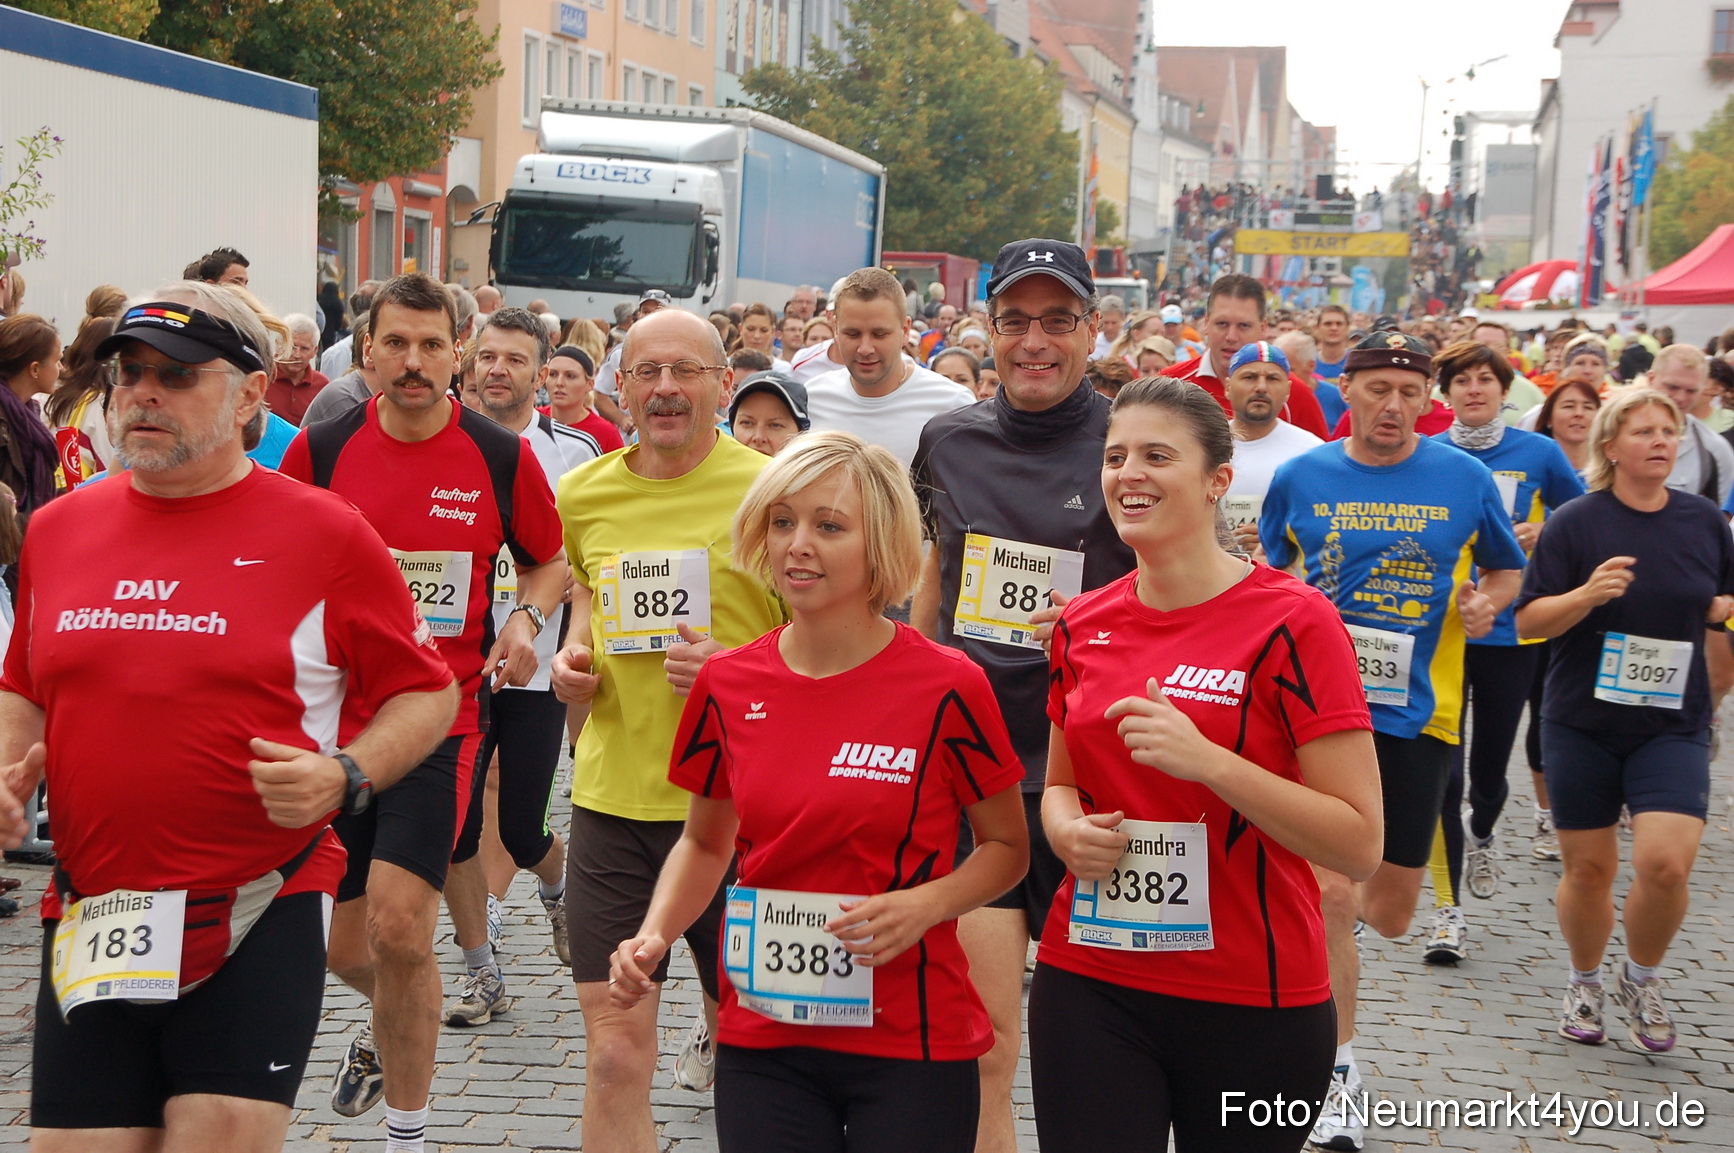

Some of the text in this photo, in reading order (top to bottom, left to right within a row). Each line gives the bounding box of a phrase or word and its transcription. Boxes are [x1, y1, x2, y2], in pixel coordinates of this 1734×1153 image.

[557, 162, 652, 184] BOCK
[1291, 235, 1349, 250] START
[431, 486, 481, 503] Lauftreff
[429, 505, 477, 525] Parsberg
[1313, 502, 1449, 521] 10. NEUMARKTER
[1330, 516, 1427, 532] STADTLAUF
[622, 558, 670, 580] Roland
[993, 547, 1051, 574] Michael
[114, 579, 180, 601] DAV
[1364, 578, 1433, 596] 20.09.2009
[634, 589, 690, 618] 882
[56, 607, 228, 635] Röthenbach
[1629, 643, 1659, 659] Birgit
[1164, 664, 1246, 695] JURA
[1626, 663, 1678, 684] 3097
[744, 711, 767, 720] erima
[831, 742, 917, 772] JURA
[828, 766, 911, 784] SPORT-Service
[1106, 868, 1189, 905] 3382
[81, 893, 153, 925] Matthias
[764, 901, 827, 927] Andrea
[87, 925, 153, 962] 183
[1081, 929, 1112, 940] BOCK
[1149, 932, 1210, 943] PFLEIDERER
[765, 941, 853, 978] 3383
[114, 979, 175, 990] PFLEIDERER
[810, 1004, 869, 1018] PFLEIDERER
